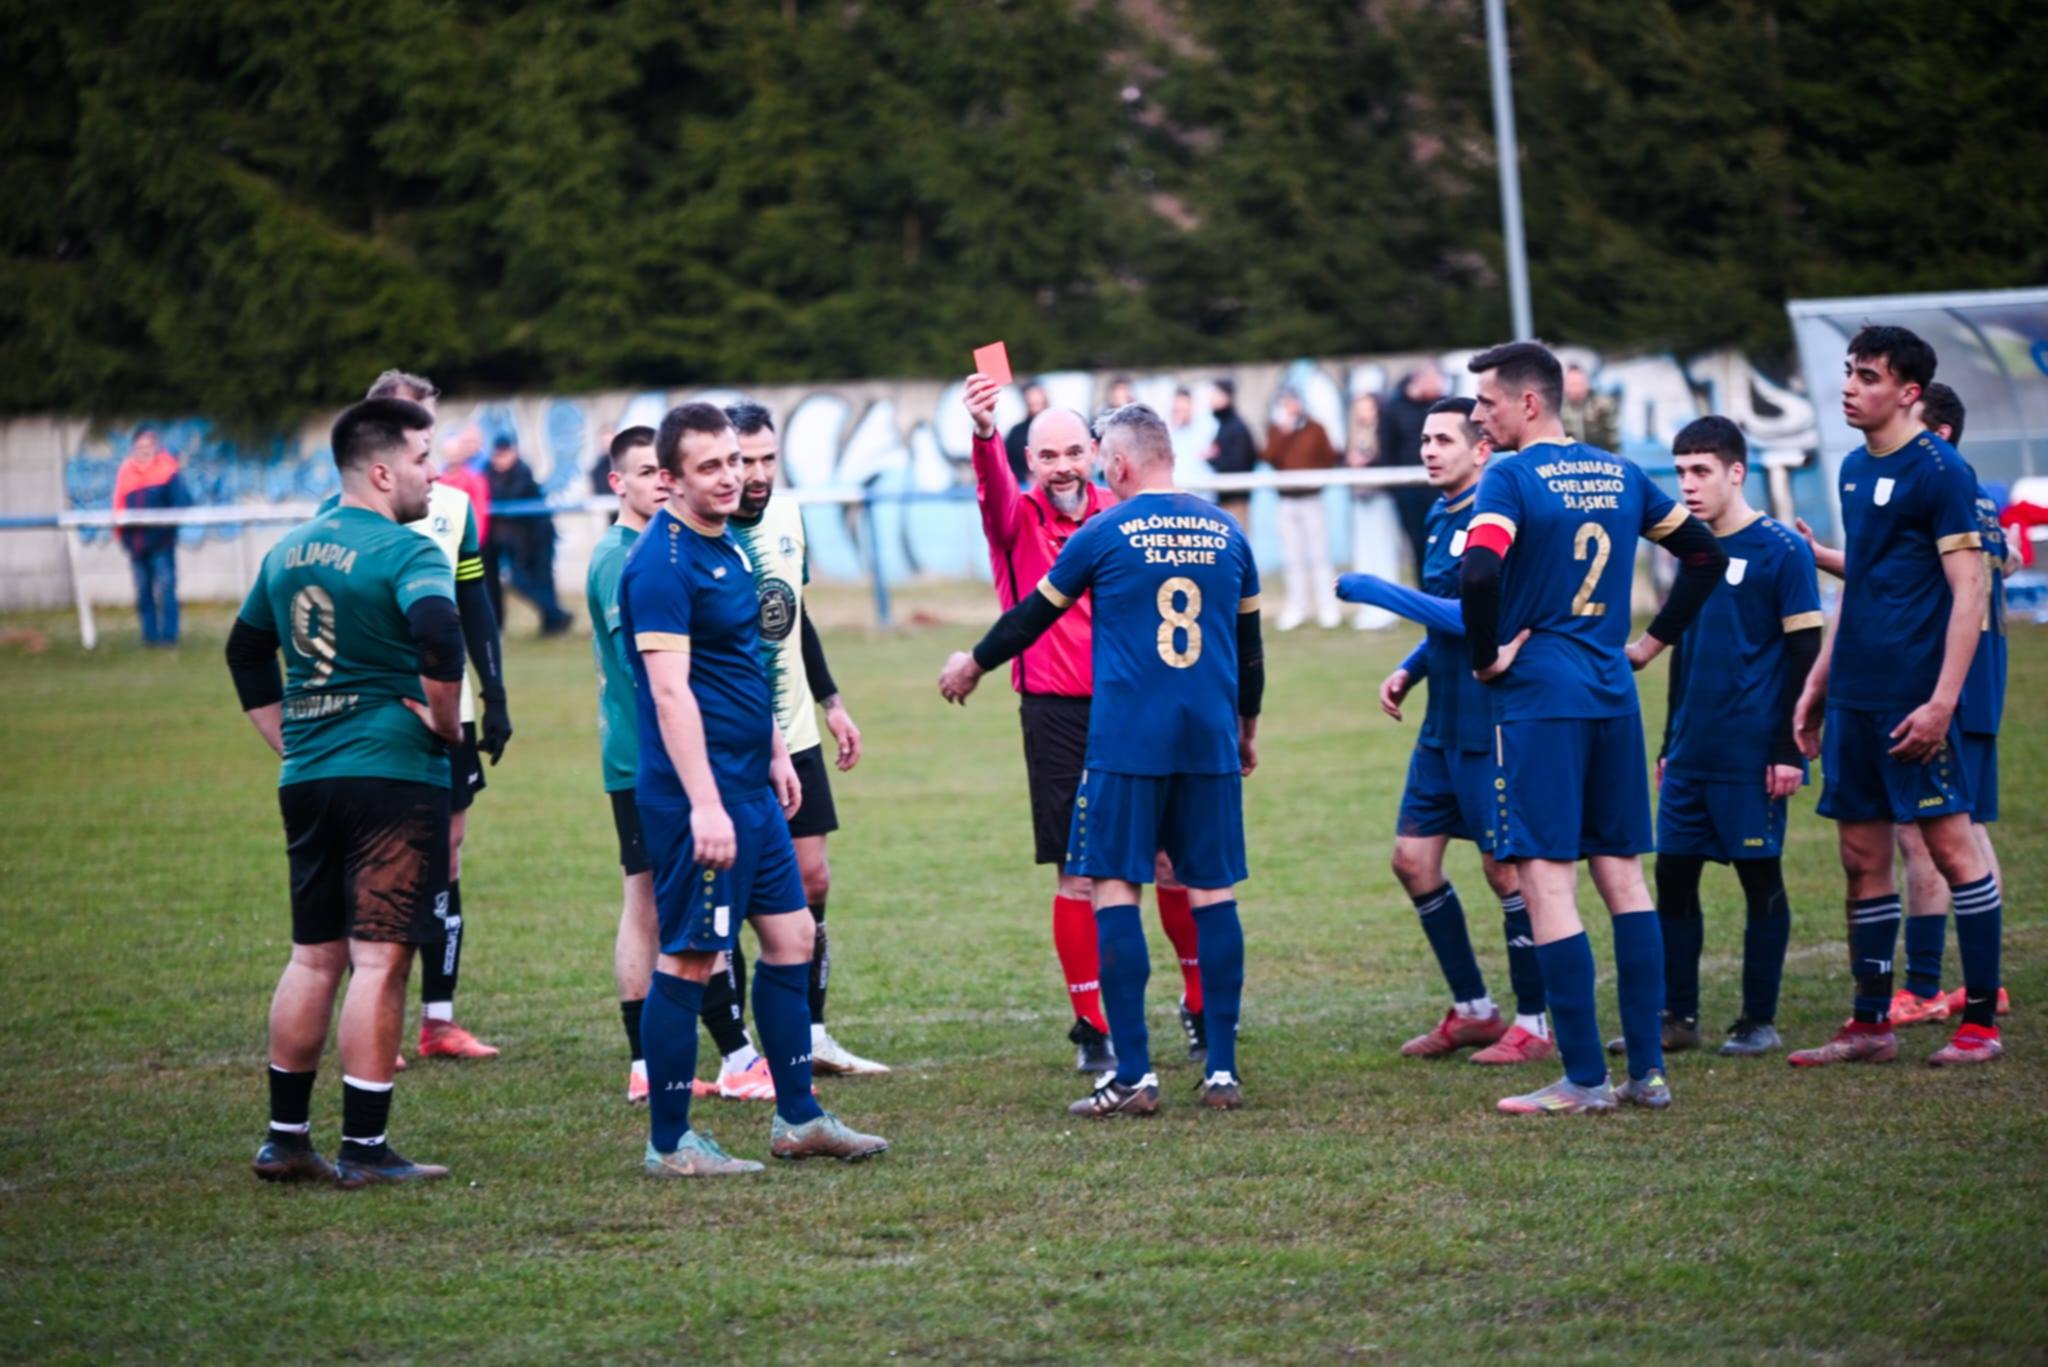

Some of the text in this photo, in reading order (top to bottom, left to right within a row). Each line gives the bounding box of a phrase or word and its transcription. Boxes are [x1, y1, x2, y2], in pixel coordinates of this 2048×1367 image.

[1118, 513, 1231, 537] WŁÓKNIARZ
[1129, 534, 1227, 550] CHEŁMSKO
[284, 541, 359, 575] OLIMPIA
[1144, 547, 1217, 567] ŚLĄSKIE
[1571, 521, 1612, 616] 2
[290, 584, 337, 689] 9
[1156, 576, 1203, 669] 8
